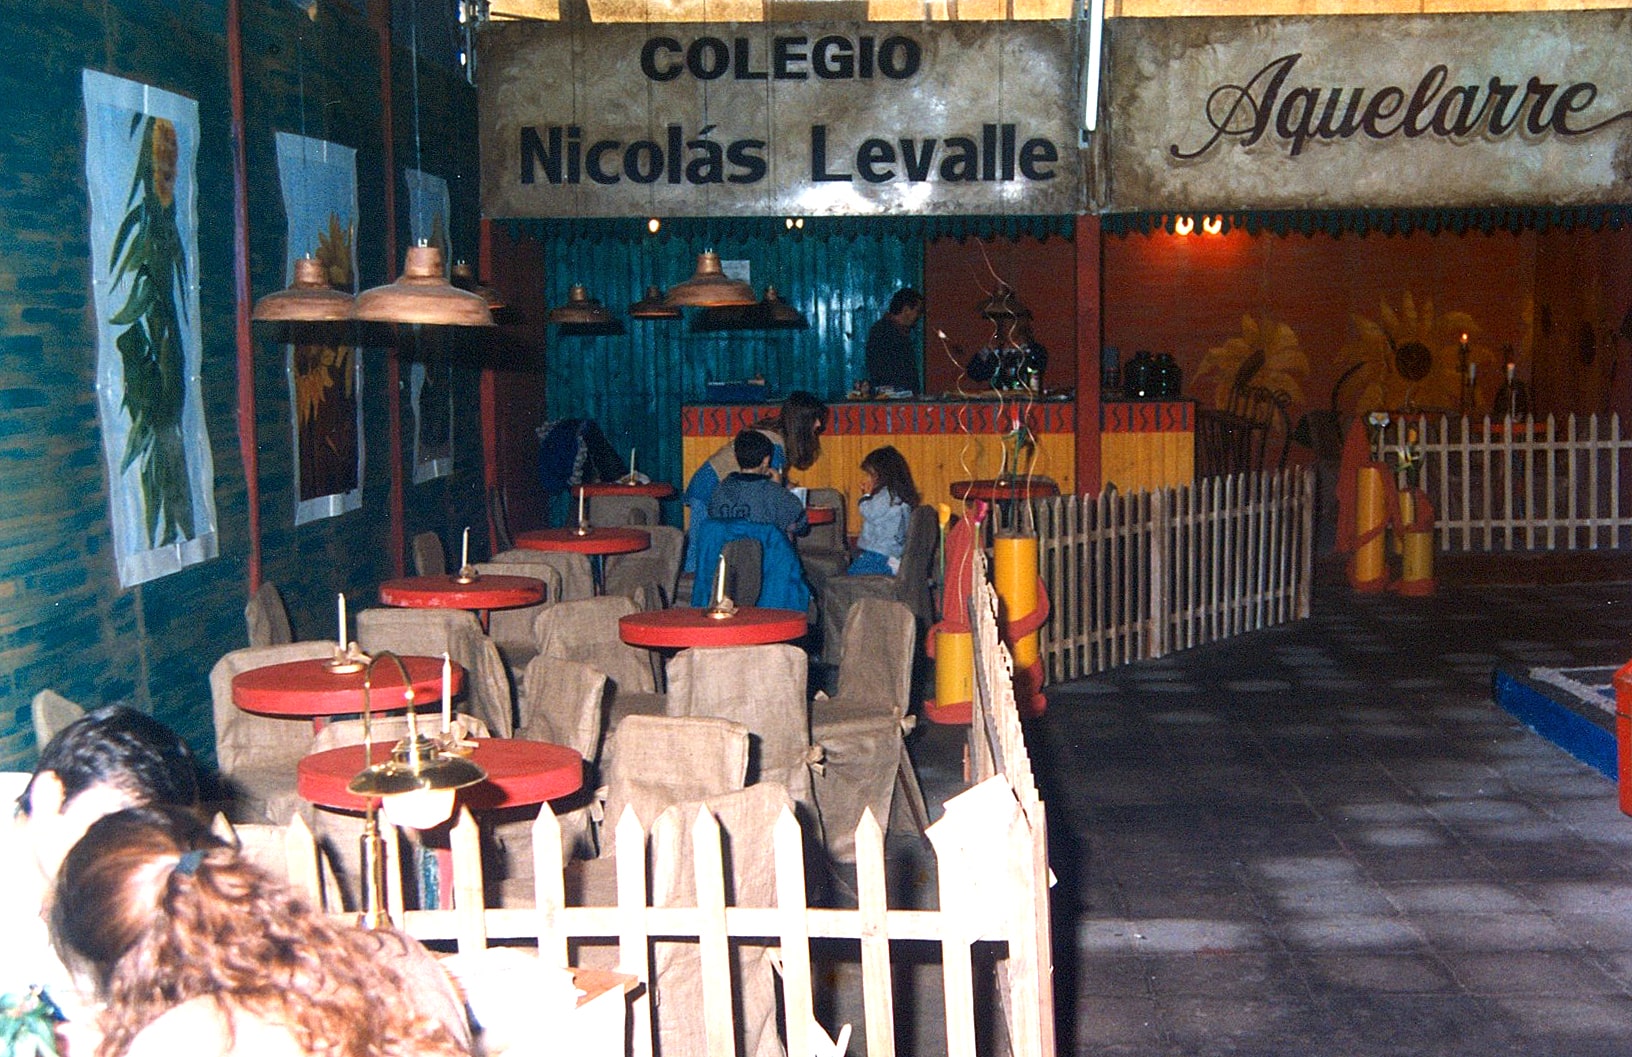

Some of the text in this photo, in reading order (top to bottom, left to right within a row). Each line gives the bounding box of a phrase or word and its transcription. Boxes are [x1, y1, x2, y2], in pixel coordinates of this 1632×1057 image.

[641, 35, 921, 81] COLEGIO
[1170, 52, 1632, 159] Aquelarre
[520, 123, 1059, 185] Nicolás Levalle
